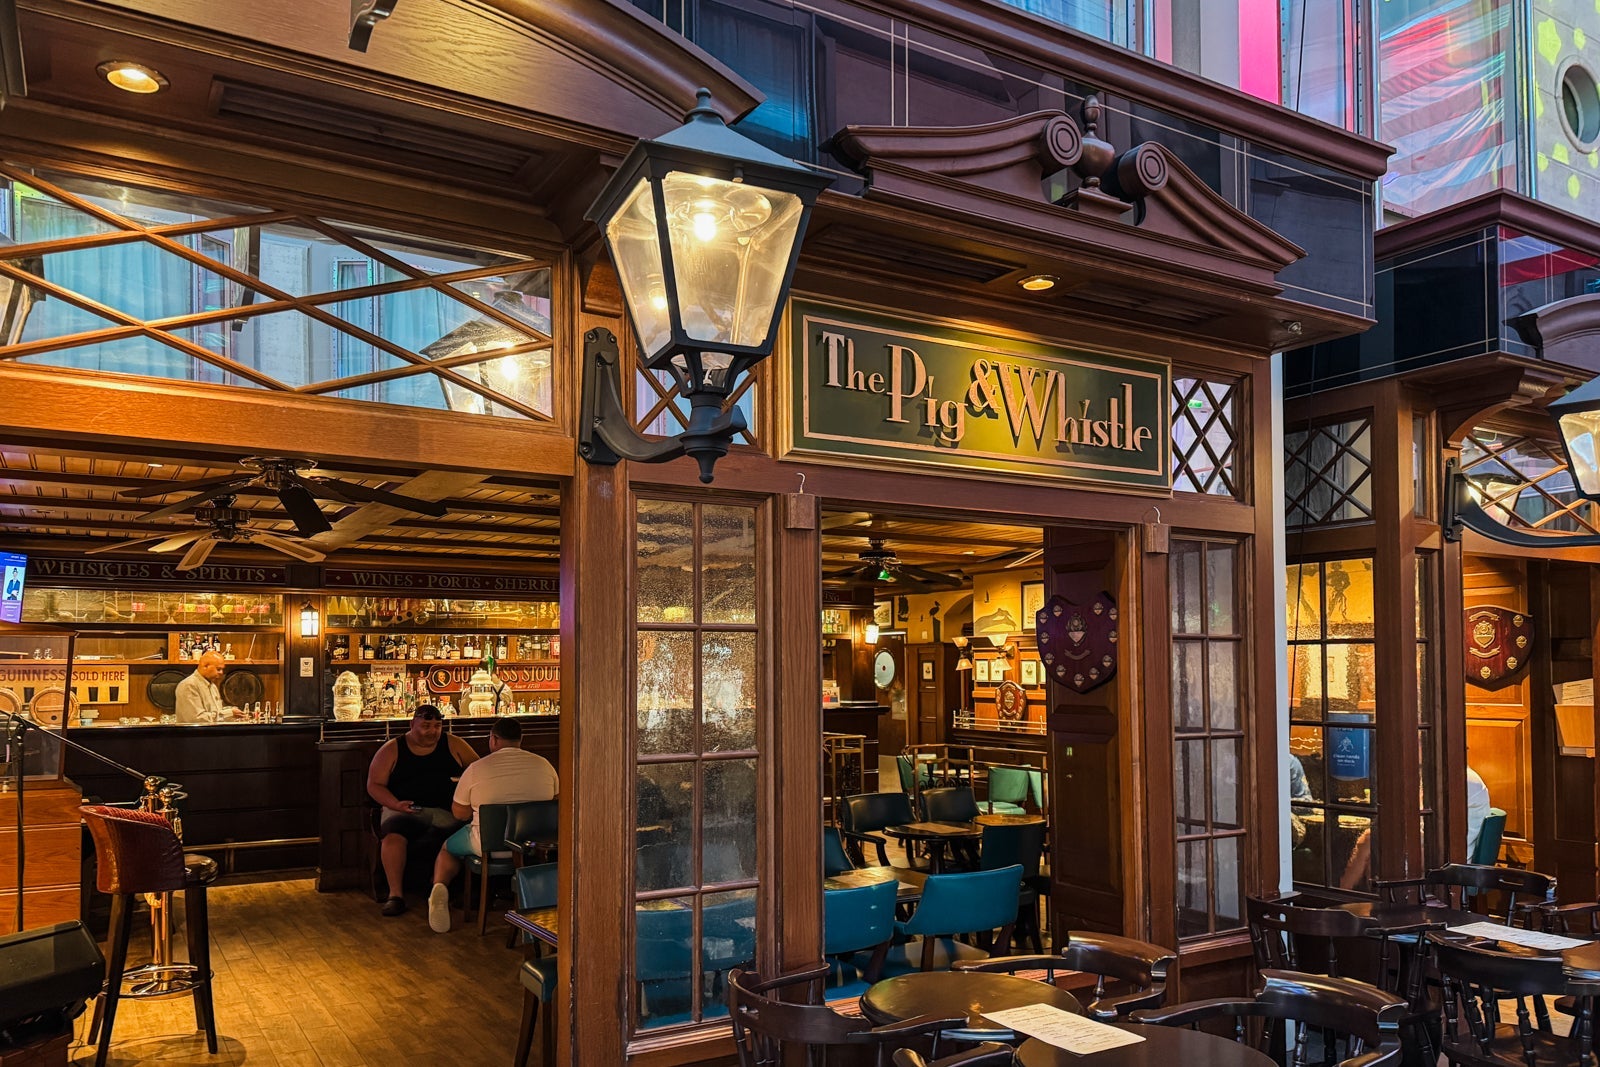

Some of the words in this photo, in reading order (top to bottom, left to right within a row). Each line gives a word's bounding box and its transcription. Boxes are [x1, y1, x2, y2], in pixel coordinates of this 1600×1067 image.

[822, 330, 885, 394] The
[886, 343, 969, 442] Pig
[967, 358, 1000, 413] &
[993, 361, 1152, 452] Whistle
[35, 560, 150, 578] WHISKIES
[161, 565, 176, 579] &
[185, 566, 265, 581] SPIRITS
[351, 572, 413, 587] WINES
[427, 574, 481, 589] PORTS
[0, 669, 66, 682] GUINNESS
[71, 671, 99, 681] SOLD
[101, 671, 125, 681] HERE
[522, 666, 560, 682] STOUT
